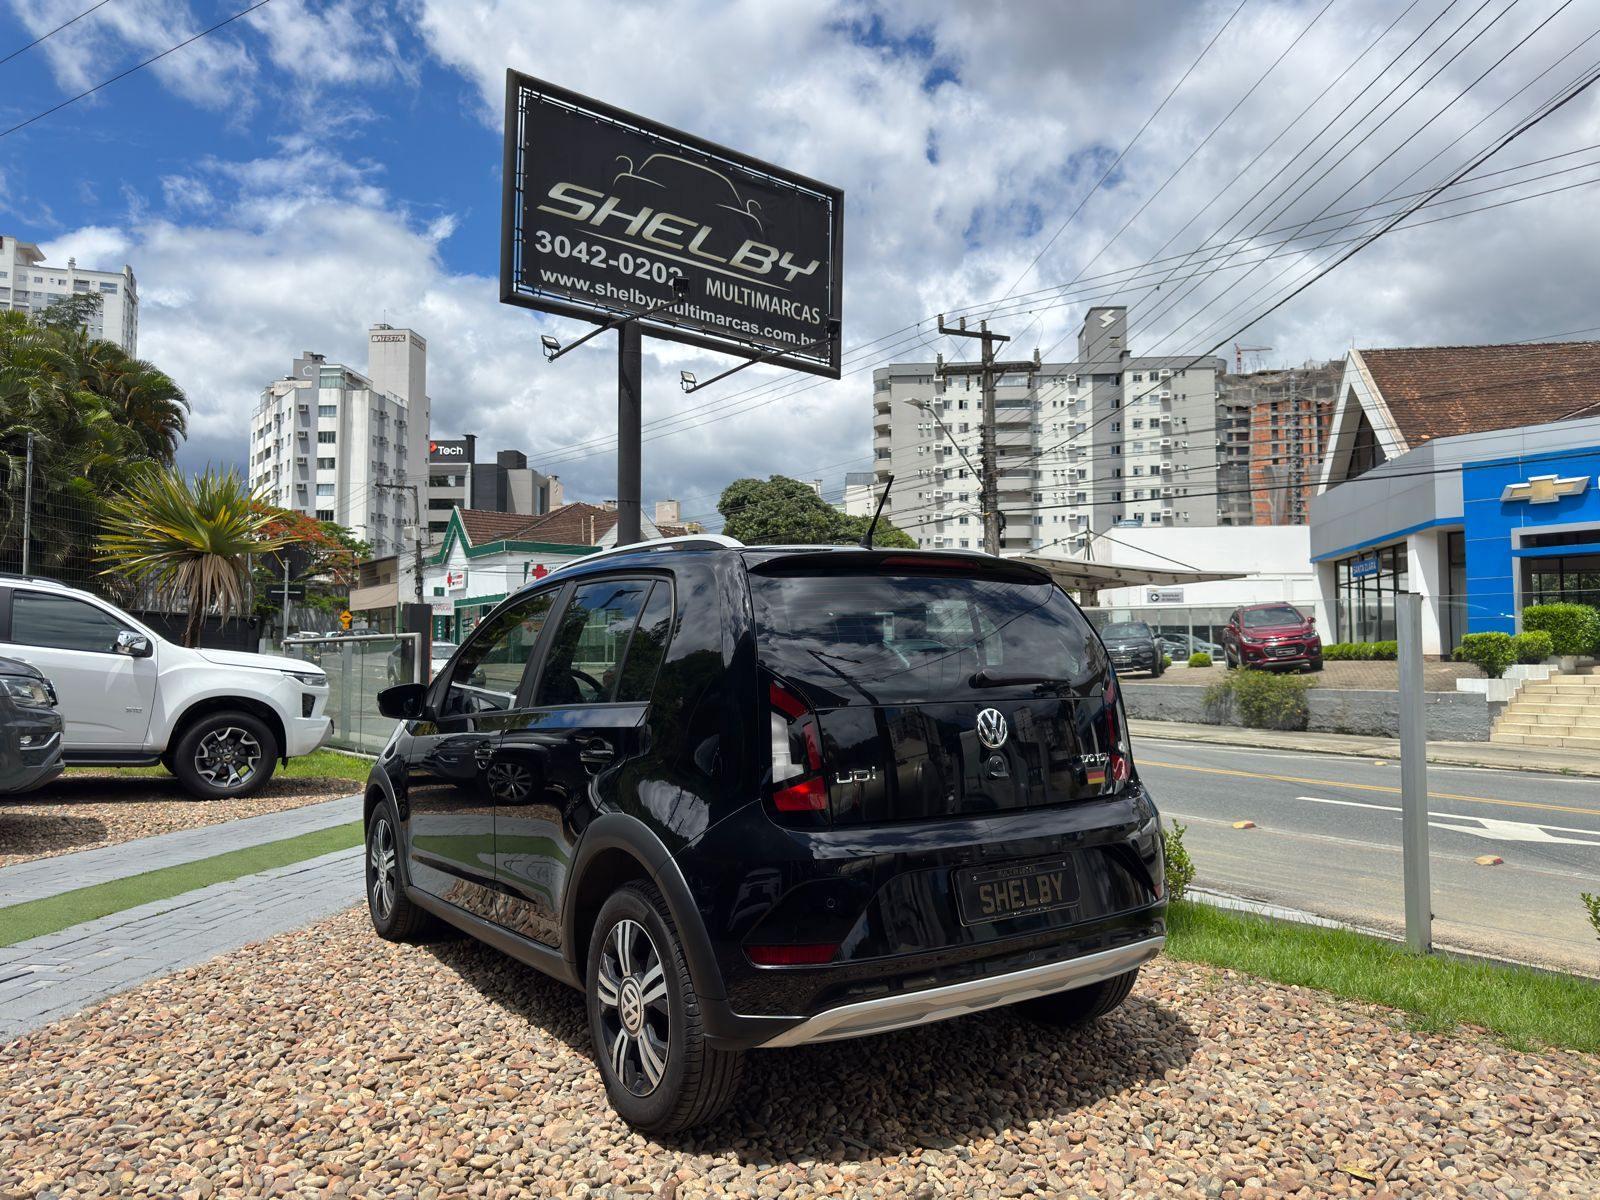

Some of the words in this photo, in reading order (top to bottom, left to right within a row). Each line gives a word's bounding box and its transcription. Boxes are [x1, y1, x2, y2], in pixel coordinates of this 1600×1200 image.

[537, 182, 820, 282] SHELBY
[706, 278, 821, 325] MULTIMARCAS
[438, 446, 463, 455] Tech
[979, 873, 1063, 914] SHELBY
